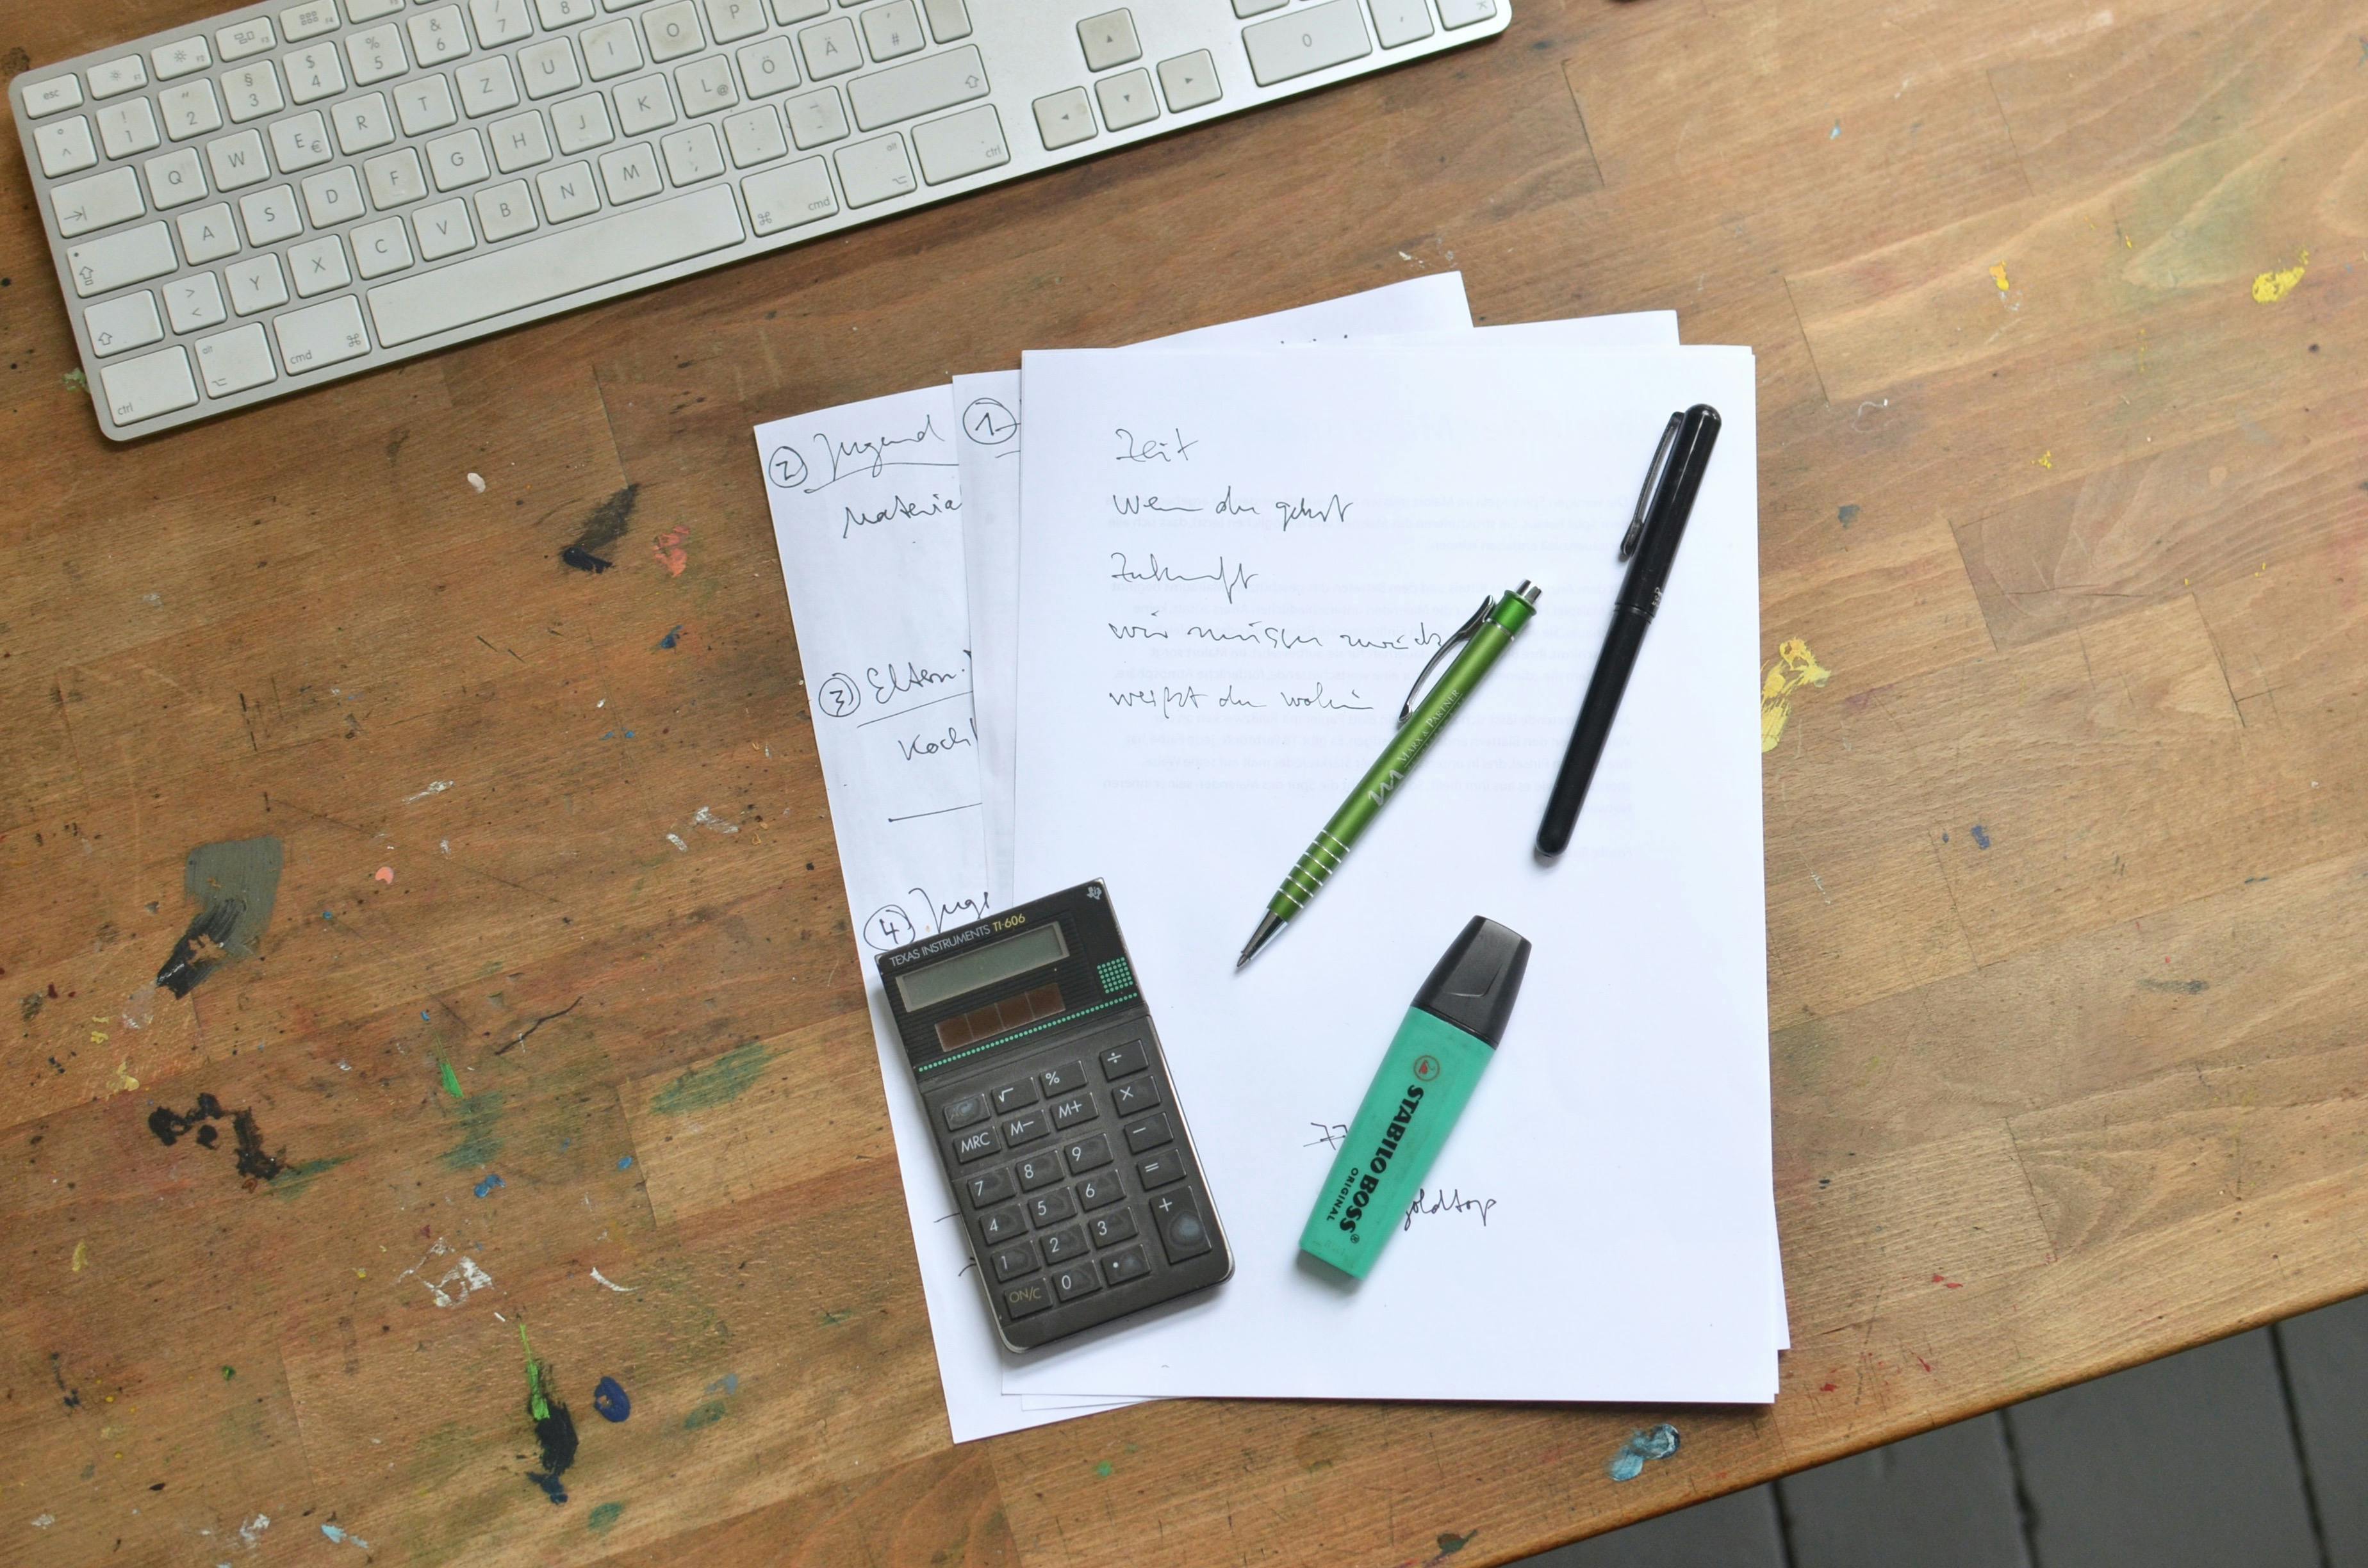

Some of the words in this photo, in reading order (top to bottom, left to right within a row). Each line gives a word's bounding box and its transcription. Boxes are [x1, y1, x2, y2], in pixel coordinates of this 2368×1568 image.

[561, 1, 570, 14] 8
[729, 4, 739, 19] P
[430, 19, 441, 31] &
[497, 19, 506, 33] 7
[666, 23, 680, 37] O
[365, 37, 380, 49] %
[437, 38, 445, 51] 6
[1303, 33, 1312, 47] 0
[825, 39, 838, 56] Ä
[306, 55, 315, 69] $
[375, 56, 383, 69] 5
[541, 60, 554, 74] U
[761, 56, 775, 74] Ö
[311, 75, 320, 87] 4
[481, 78, 492, 94] Z
[702, 79, 712, 93] L
[44, 88, 59, 100] esc
[717, 84, 728, 96] @
[249, 94, 259, 106] 3
[418, 97, 427, 111] T
[638, 96, 651, 111] K
[186, 111, 197, 125] 2
[356, 115, 367, 129] R
[579, 115, 586, 129] J
[126, 130, 133, 142] 1
[294, 134, 304, 148] E
[513, 133, 526, 148] H
[311, 140, 322, 152] €
[886, 142, 897, 152] alt
[985, 145, 1001, 158] ctrl
[228, 152, 245, 167] W
[451, 152, 464, 167] G
[169, 170, 183, 184] Q
[390, 171, 399, 185] F
[623, 165, 639, 181] M
[326, 190, 338, 204] D
[561, 183, 574, 199] N
[500, 203, 511, 217] B
[808, 197, 830, 211] cmd
[264, 208, 275, 222] S
[202, 226, 215, 240] A
[436, 220, 448, 235] V
[375, 239, 387, 253] C
[312, 257, 326, 273] X
[249, 276, 261, 291] Y
[202, 345, 213, 354] alt
[290, 350, 313, 364] cmd
[117, 402, 134, 416] ctrl
[1425, 689, 1460, 728] PARTNER
[889, 949, 921, 967] TEXAS
[922, 924, 991, 956] INSTRUMENTS
[992, 913, 1026, 932] TI-606
[1046, 1072, 1060, 1085] %
[1059, 1100, 1081, 1118] M+
[1369, 1084, 1424, 1174] STABILO
[961, 1132, 990, 1153] MRC
[1072, 1147, 1081, 1161] 9
[1024, 1164, 1033, 1179] 8
[974, 1180, 983, 1196] 7
[1085, 1184, 1095, 1198] 6
[1326, 1167, 1360, 1221] ORIGINAL
[1037, 1201, 1046, 1215] 5
[1339, 1173, 1379, 1234] BOSS
[990, 1219, 998, 1232] 4
[1098, 1221, 1107, 1235] 3
[1049, 1237, 1060, 1252] 2
[1001, 1256, 1008, 1270] 1
[1062, 1275, 1072, 1289] 0
[1009, 1287, 1041, 1303] ON/C
